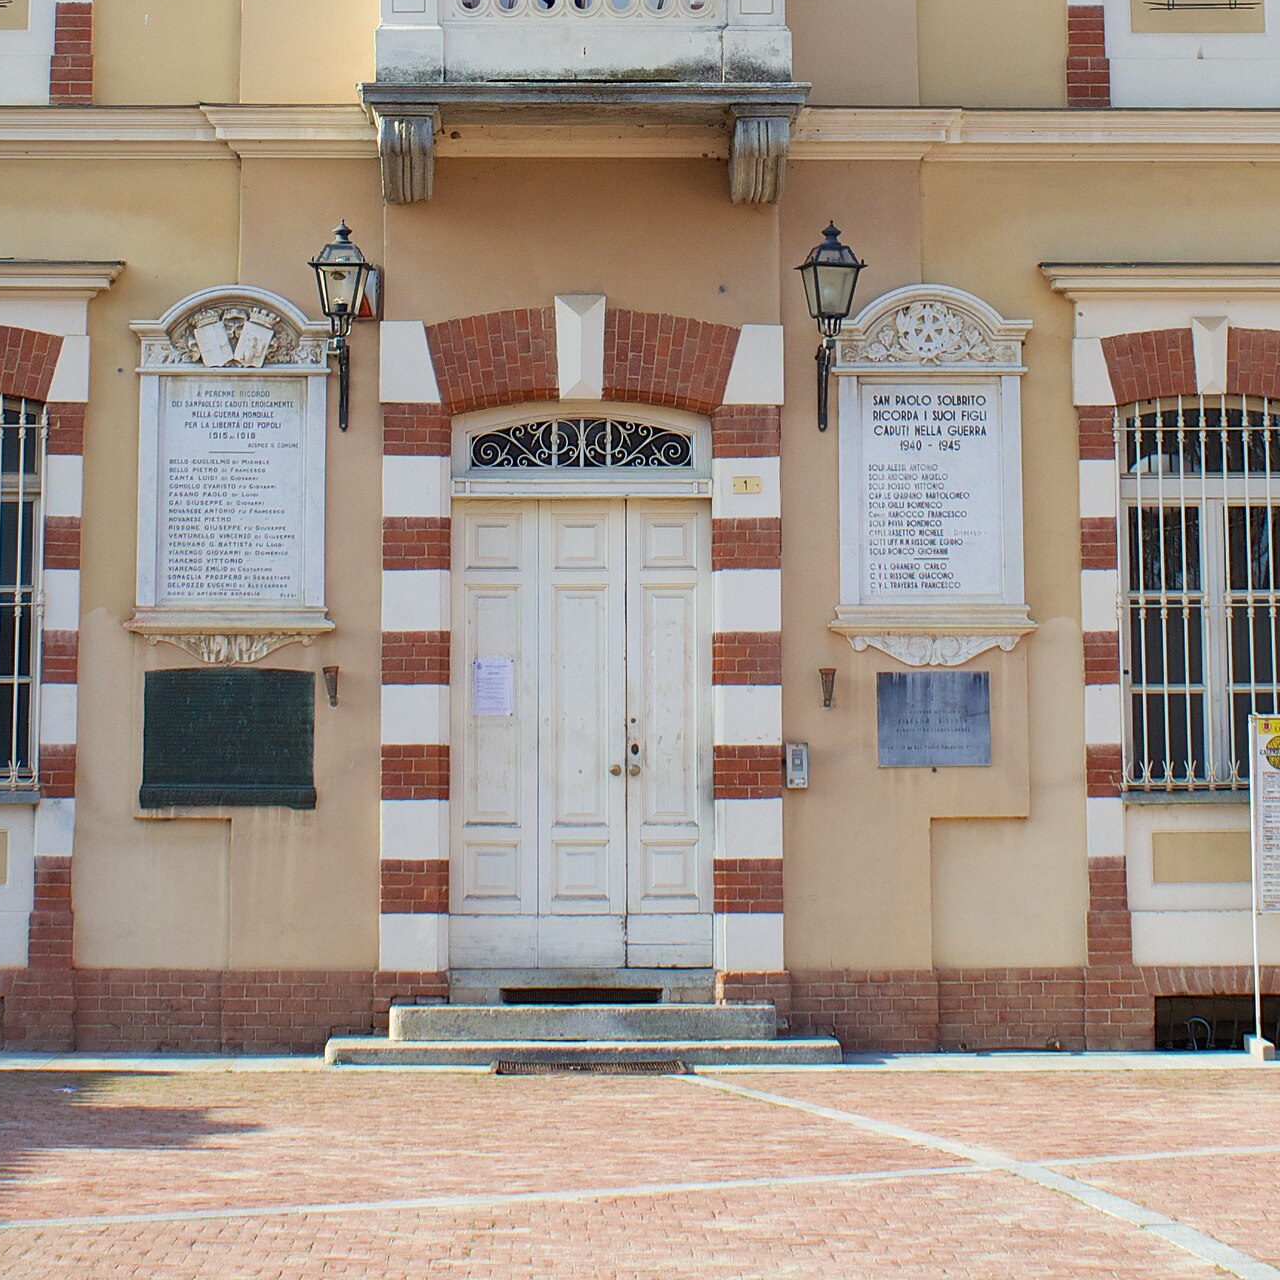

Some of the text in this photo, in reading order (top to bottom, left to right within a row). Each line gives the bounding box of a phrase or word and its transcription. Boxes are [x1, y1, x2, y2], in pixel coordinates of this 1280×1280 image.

[872, 394, 986, 406] SAN PAOLO SOLBRITO
[191, 411, 274, 419] NELLA GUERRA MONDIALE
[872, 410, 919, 422] RICORDA
[932, 410, 956, 422] SUOI
[961, 410, 987, 422] FIGLI
[184, 421, 198, 429] PER
[200, 421, 210, 429] LA
[243, 421, 254, 429] DEI
[257, 421, 281, 429] POPOLI
[873, 425, 987, 437] CADUTI NELLA GUERRA
[208, 432, 228, 440] 1915
[236, 432, 256, 440] 1918
[900, 439, 922, 451] 1940
[938, 439, 961, 451] 1945
[921, 473, 949, 481] ANGELO
[743, 480, 748, 491] 1
[914, 482, 945, 491] VITTORIO
[925, 492, 970, 500] BARTOLOMEO
[907, 501, 943, 509] DOMENICO
[927, 510, 968, 519] FRANCESCO
[906, 519, 943, 527] DOMENICO
[918, 529, 944, 537] MICHELE
[888, 547, 915, 556] RONCO
[924, 563, 947, 571] CARLO
[889, 572, 955, 580] RISSONE GIACOMO
[920, 581, 961, 589] FRANCESCO
